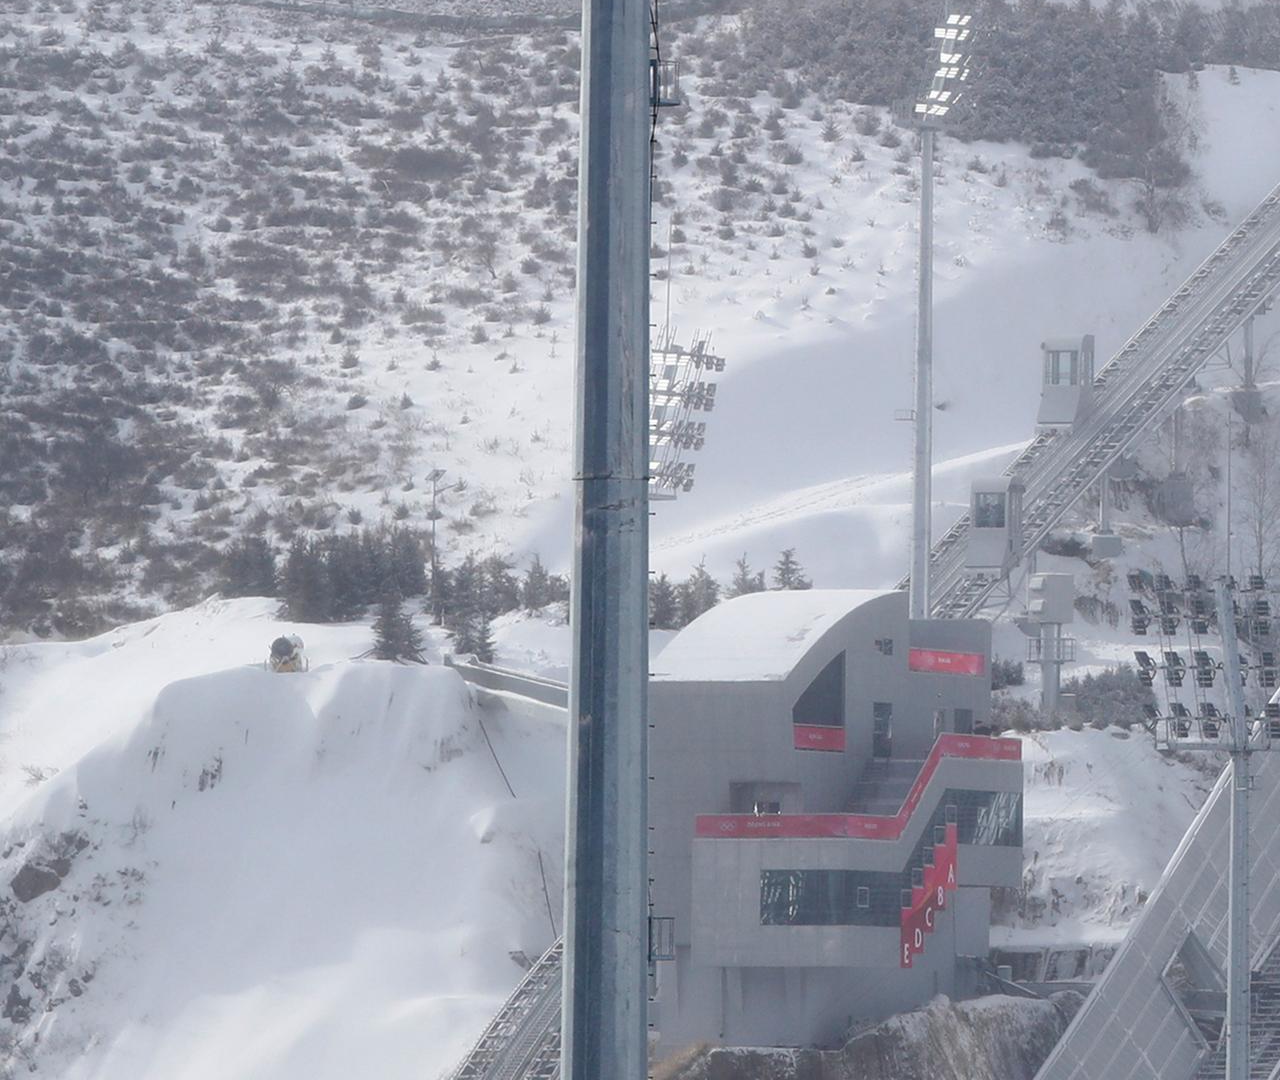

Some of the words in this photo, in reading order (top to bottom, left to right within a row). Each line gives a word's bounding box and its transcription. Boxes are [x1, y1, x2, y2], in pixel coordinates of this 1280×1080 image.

[947, 863, 955, 883] A
[925, 907, 932, 927] C
[914, 928, 922, 948] D
[904, 943, 910, 963] E
